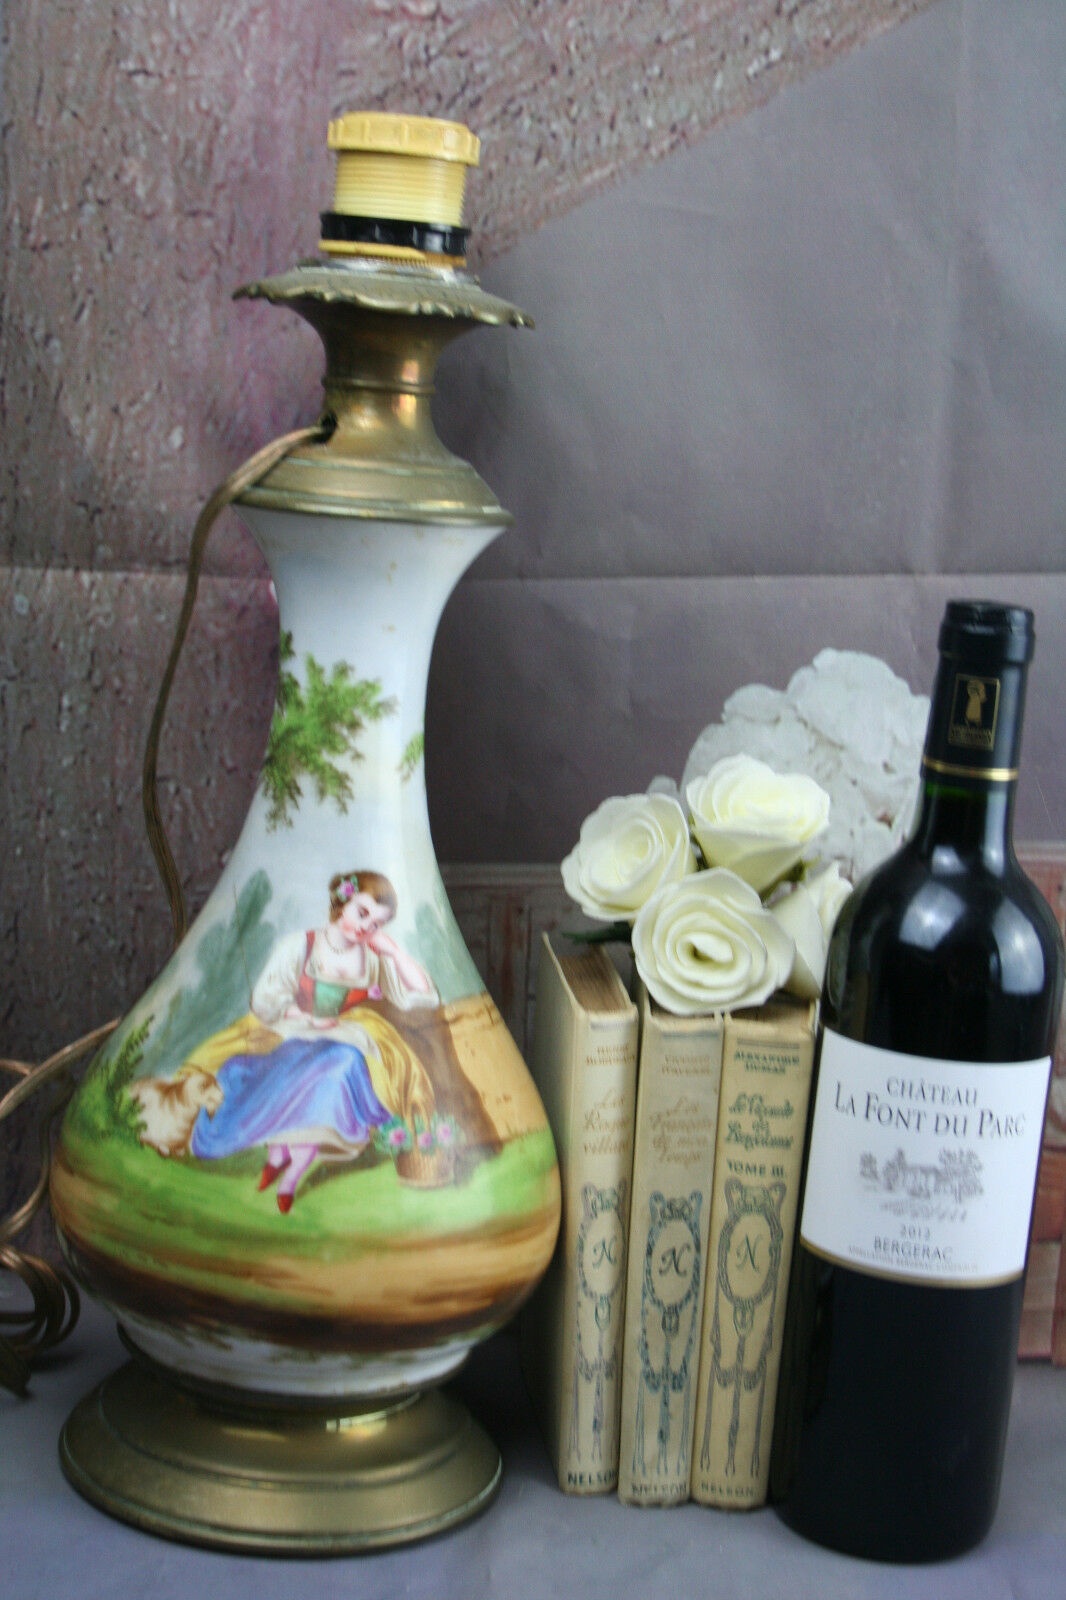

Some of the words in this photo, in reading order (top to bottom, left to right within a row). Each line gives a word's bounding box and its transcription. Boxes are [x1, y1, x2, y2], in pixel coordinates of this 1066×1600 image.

[935, 1112, 968, 1138] DU
[727, 1159, 766, 1177] TOME
[771, 1165, 784, 1178] III
[874, 1234, 952, 1263] BERGERAC
